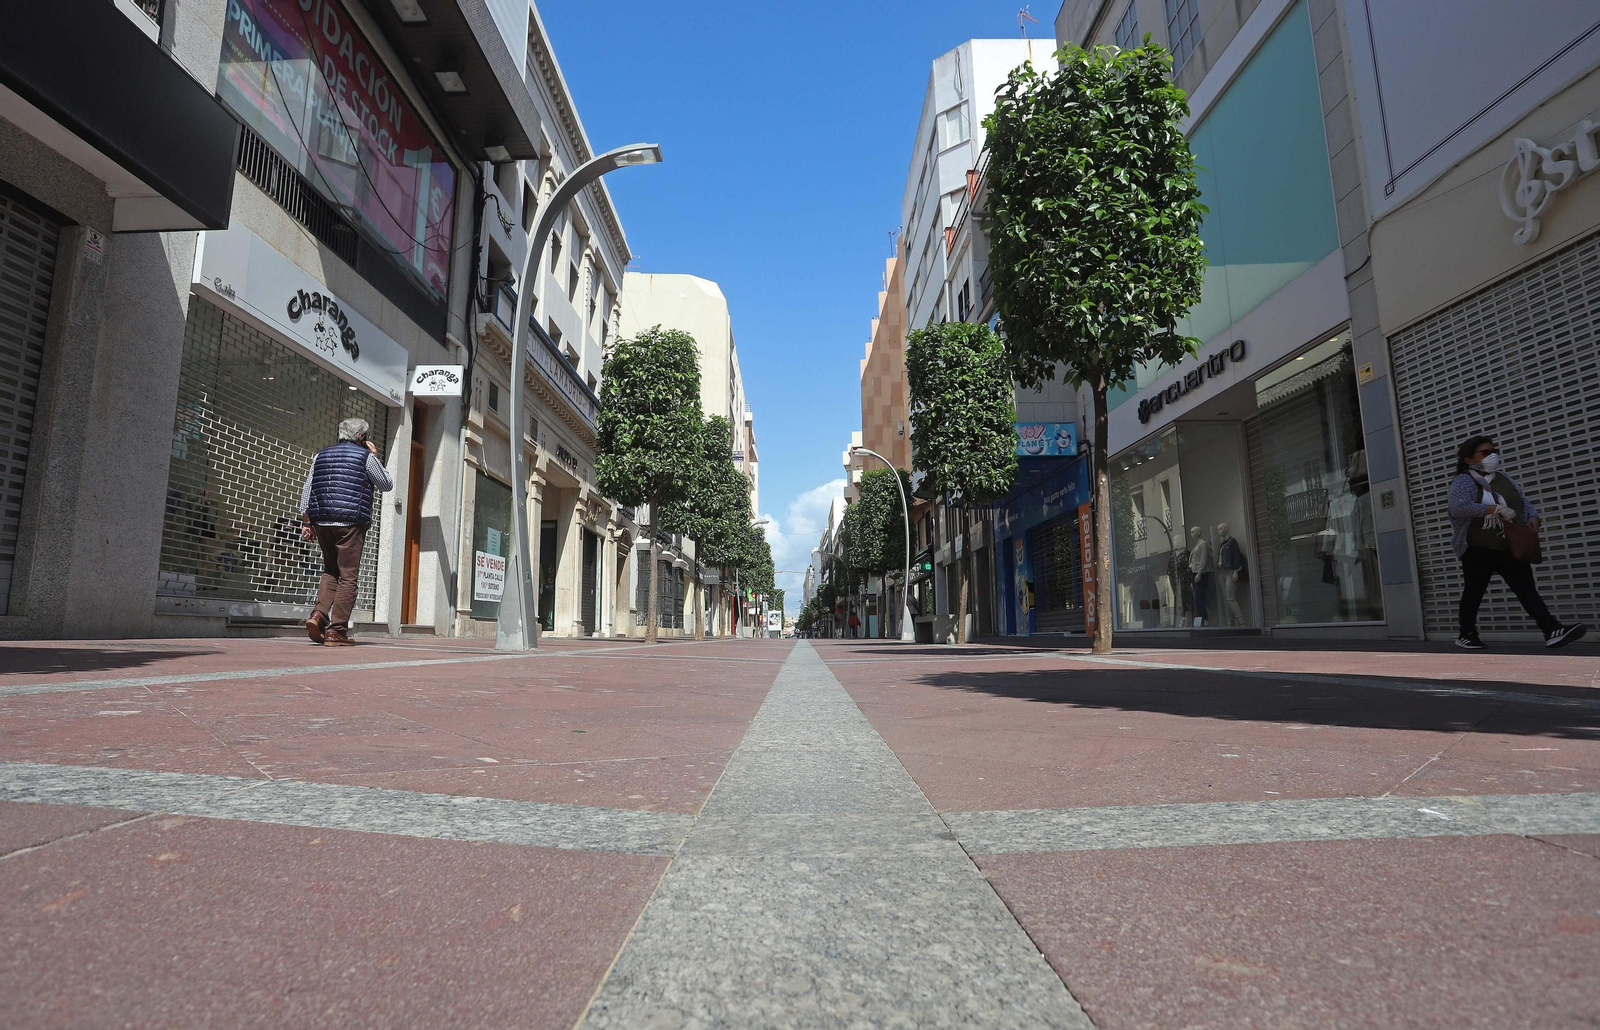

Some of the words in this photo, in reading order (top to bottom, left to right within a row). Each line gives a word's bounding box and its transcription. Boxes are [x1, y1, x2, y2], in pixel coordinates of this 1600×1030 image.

[227, 0, 306, 103] PRIMERA
[307, 88, 360, 162] PLANTA
[299, 0, 402, 134] IDACIÓN
[324, 54, 347, 103] DE
[351, 90, 398, 167] STOCK
[1148, 339, 1246, 414] encuentro
[1017, 425, 1045, 440] TOY
[476, 555, 485, 568] SE
[486, 557, 505, 572] VENDE
[1082, 513, 1093, 583] Planet
[1086, 589, 1096, 626] Toy
